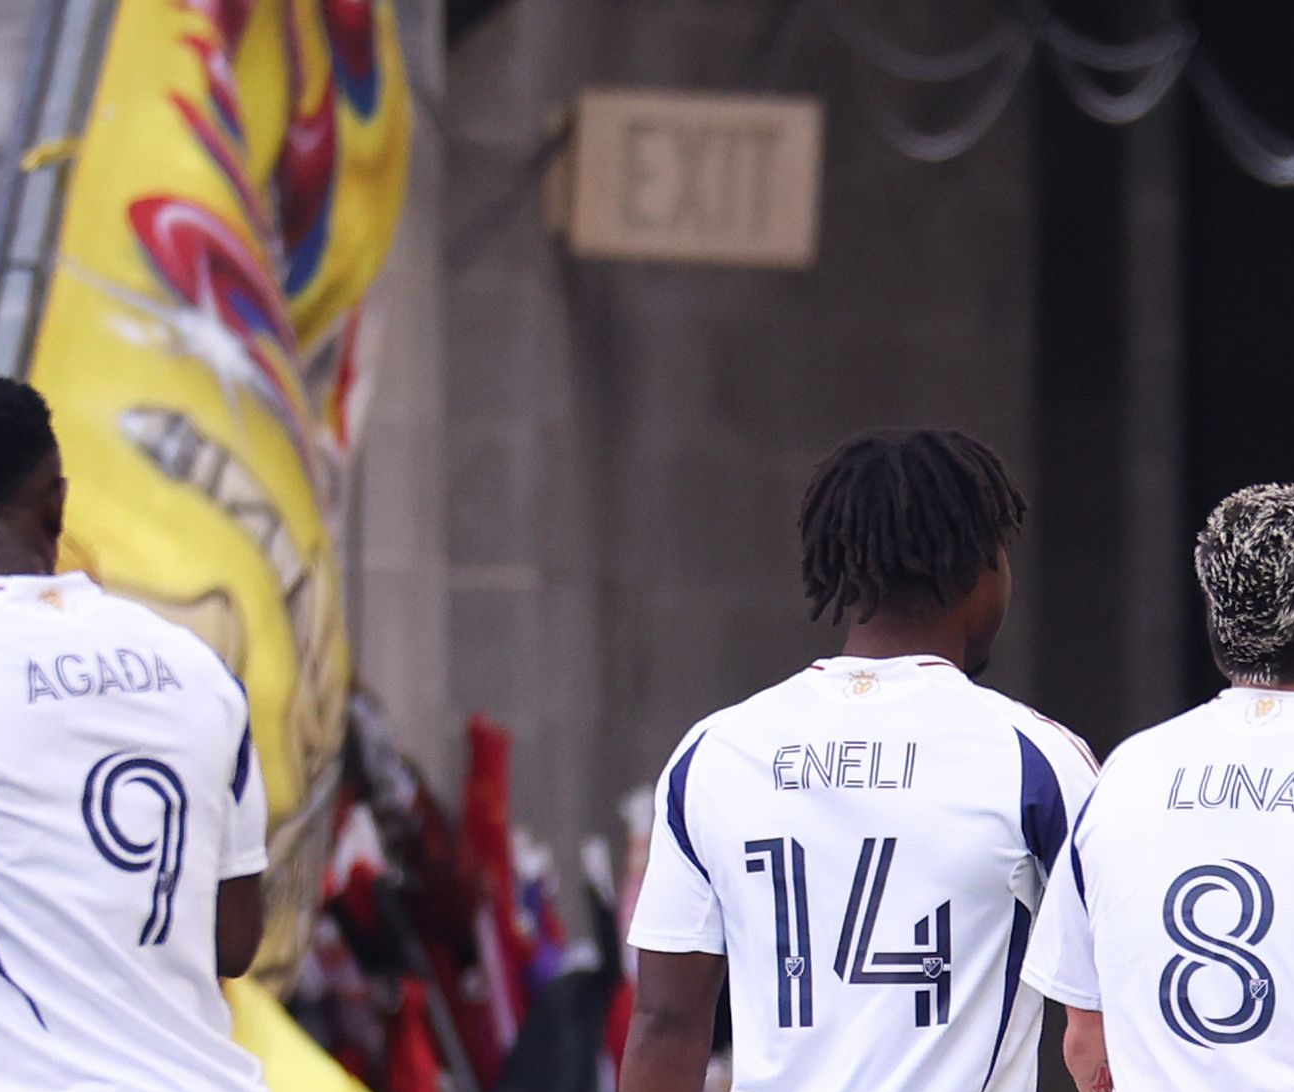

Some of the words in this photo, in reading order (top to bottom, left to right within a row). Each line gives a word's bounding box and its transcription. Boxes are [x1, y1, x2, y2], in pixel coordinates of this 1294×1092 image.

[619, 116, 785, 242] EXIT
[27, 648, 182, 704] AGADA
[772, 741, 917, 790] ENELI
[81, 750, 188, 946] 9
[744, 837, 952, 1029] 14
[1158, 858, 1276, 1050] 8
